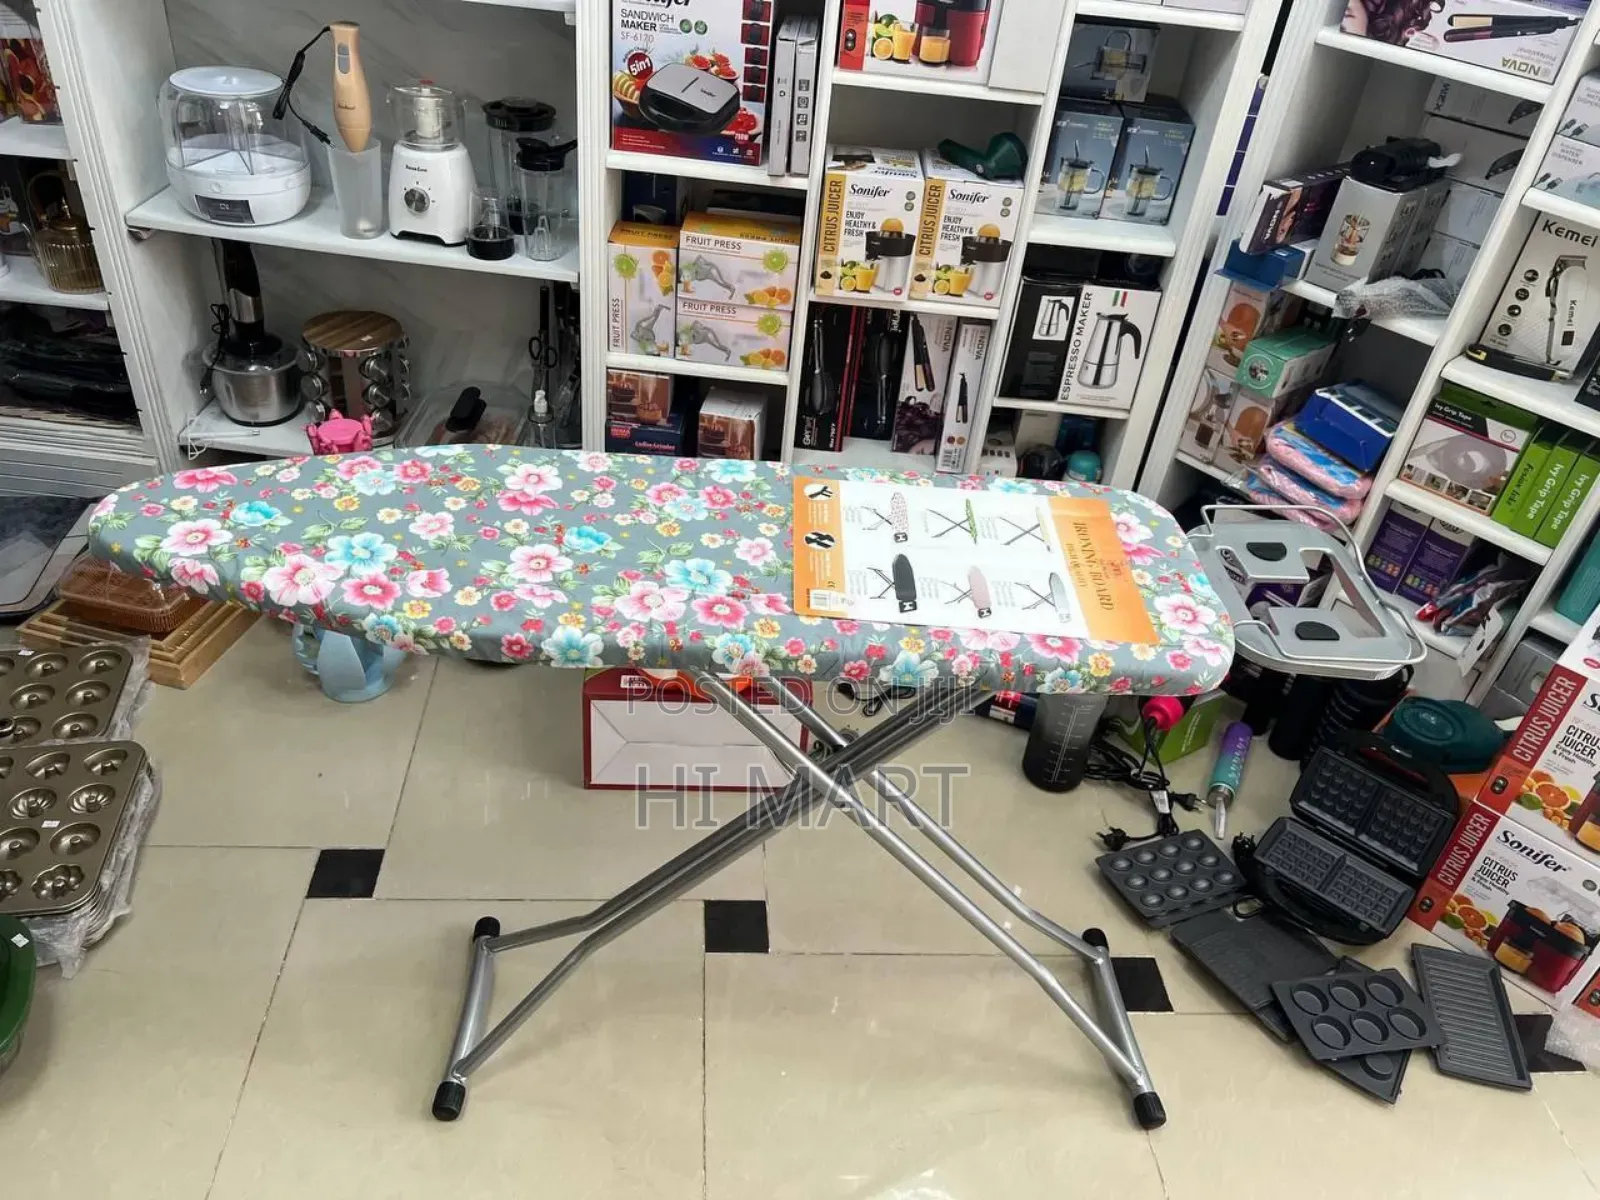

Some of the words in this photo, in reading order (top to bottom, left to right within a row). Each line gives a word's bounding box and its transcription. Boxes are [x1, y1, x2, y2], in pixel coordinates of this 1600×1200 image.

[620, 9, 675, 23] SANDWICH
[621, 20, 657, 31] MAKER
[630, 57, 651, 75] 5in1
[1502, 57, 1541, 76] NOVA
[828, 180, 842, 215] JUICER
[850, 183, 891, 198] Sonifer
[949, 188, 990, 204] Sonifer
[924, 184, 941, 219] JUICER
[845, 220, 871, 229] HEALTHY
[846, 211, 865, 219] ENJOY
[944, 215, 962, 224] ENJOY
[1264, 209, 1281, 240] NOVA
[823, 215, 838, 252] CITRUS
[843, 229, 864, 237] FRESH
[919, 219, 935, 256] CITRUS
[940, 232, 960, 241] FRESH
[942, 224, 968, 234] HEALTHY
[1542, 219, 1598, 248] Kemei
[685, 235, 712, 247] FRUIT
[714, 238, 741, 251] PRESS
[612, 298, 620, 324] PRESS
[683, 301, 708, 312] FRUIT
[710, 304, 737, 315] PRESS
[1566, 299, 1577, 326] Kemei
[612, 325, 620, 348] FRUIT
[942, 325, 953, 352] NOVA
[975, 330, 987, 360] NOVA
[1061, 338, 1082, 400] ESPRESSO
[1078, 291, 1093, 337] MAKER
[1444, 406, 1458, 417] Grip
[1458, 411, 1473, 421] Tape
[1549, 463, 1565, 478] Ivy
[1539, 478, 1556, 498] Grip
[1575, 474, 1590, 488] Ivy
[1564, 488, 1580, 508] Grip
[1526, 500, 1546, 520] Tape
[1551, 510, 1569, 530] Tape
[1073, 521, 1097, 567] IRONING
[1089, 571, 1115, 611] BOARD
[1513, 720, 1552, 763] CITRUS
[1540, 675, 1577, 722] JUICER
[1558, 735, 1597, 759] JUICER
[1437, 851, 1471, 886] CITRUS
[1459, 813, 1492, 854] JUICER
[1496, 829, 1568, 872] Sonifer
[1477, 865, 1510, 888] JUICER
[1483, 856, 1518, 881] CITRUS
